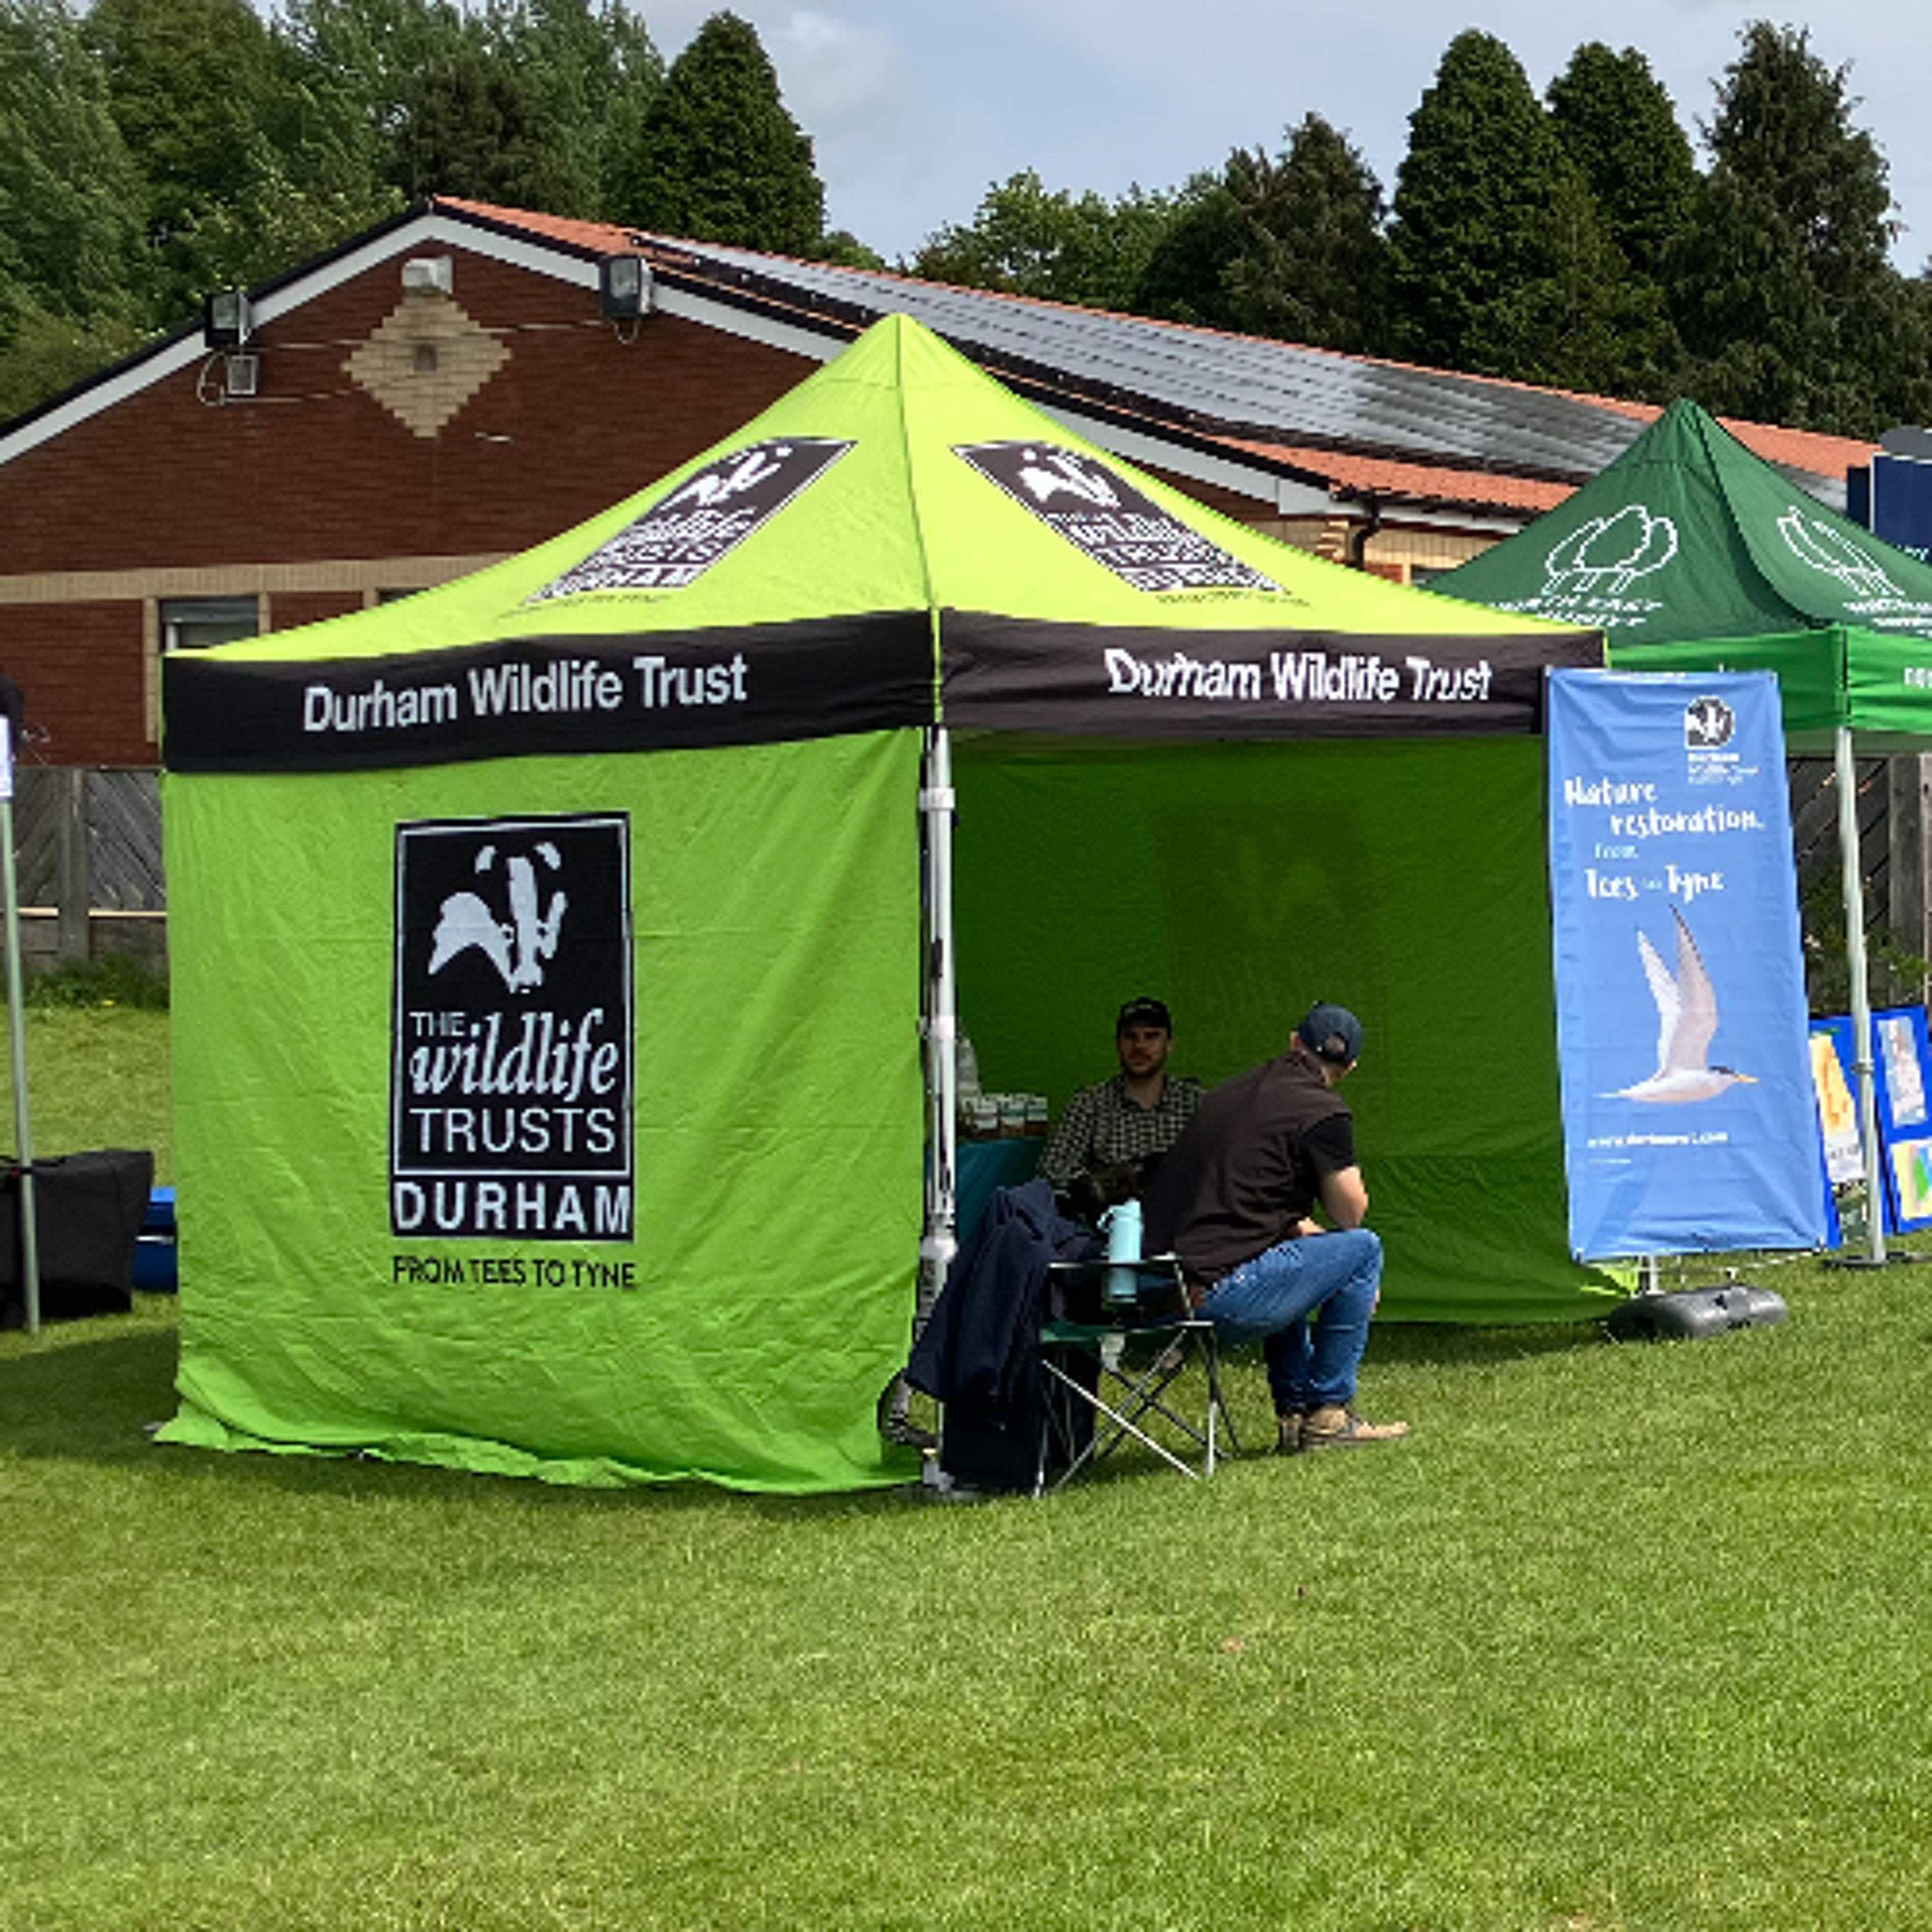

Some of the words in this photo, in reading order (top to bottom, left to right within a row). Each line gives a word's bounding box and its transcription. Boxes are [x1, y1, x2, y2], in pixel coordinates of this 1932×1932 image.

[304, 679, 457, 732] Durham
[468, 659, 623, 715] Wildlife
[633, 653, 748, 707] Trust
[1104, 648, 1260, 699] Durham
[1271, 652, 1399, 701] Wildlife
[1406, 656, 1492, 701] Trust
[1565, 777, 1657, 806] Nature
[1611, 805, 1765, 837] restoration
[1584, 868, 1639, 900] Tees
[1665, 863, 1724, 904] Tyne
[409, 1012, 465, 1036] THE
[409, 1008, 618, 1103] wildlife
[409, 1108, 615, 1153] TRUSTS
[393, 1182, 630, 1234] DURHAM
[393, 1256, 464, 1283] FROM
[468, 1258, 526, 1285] TEES
[532, 1260, 565, 1287] TO
[572, 1260, 636, 1289] TYNE
